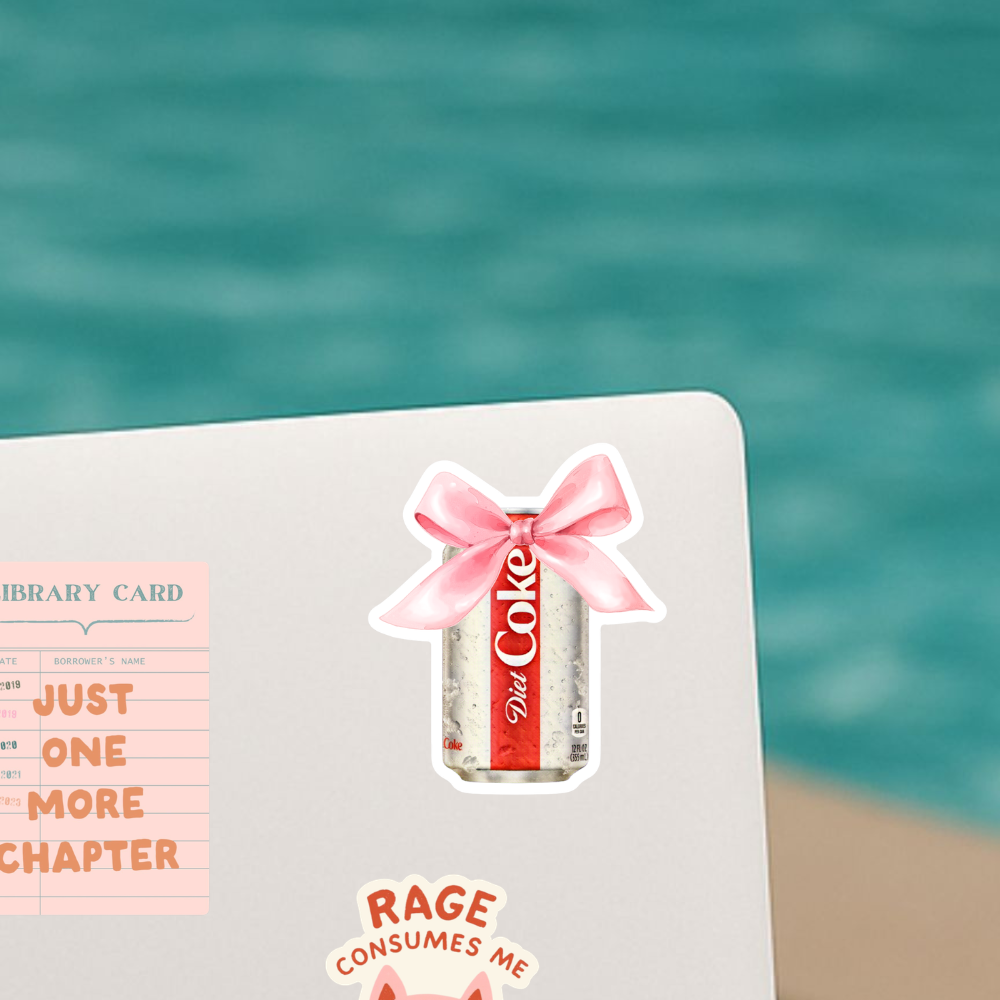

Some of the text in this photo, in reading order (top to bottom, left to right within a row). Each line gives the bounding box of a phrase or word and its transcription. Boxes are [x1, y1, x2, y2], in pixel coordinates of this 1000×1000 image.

[112, 584, 184, 602] CARD
[494, 548, 537, 724] Diet Coke
[54, 657, 146, 666] BORROWER'S NAME
[0, 680, 21, 691] 2019
[33, 683, 133, 716] JUST
[577, 711, 582, 723] 0
[42, 735, 126, 767] ONE
[443, 737, 463, 751] Coke
[1, 770, 21, 779] 2021
[0, 796, 21, 807] 2023
[27, 787, 144, 821] MORE
[367, 885, 497, 929] RAGE
[336, 930, 529, 979] CONSUMES ME
